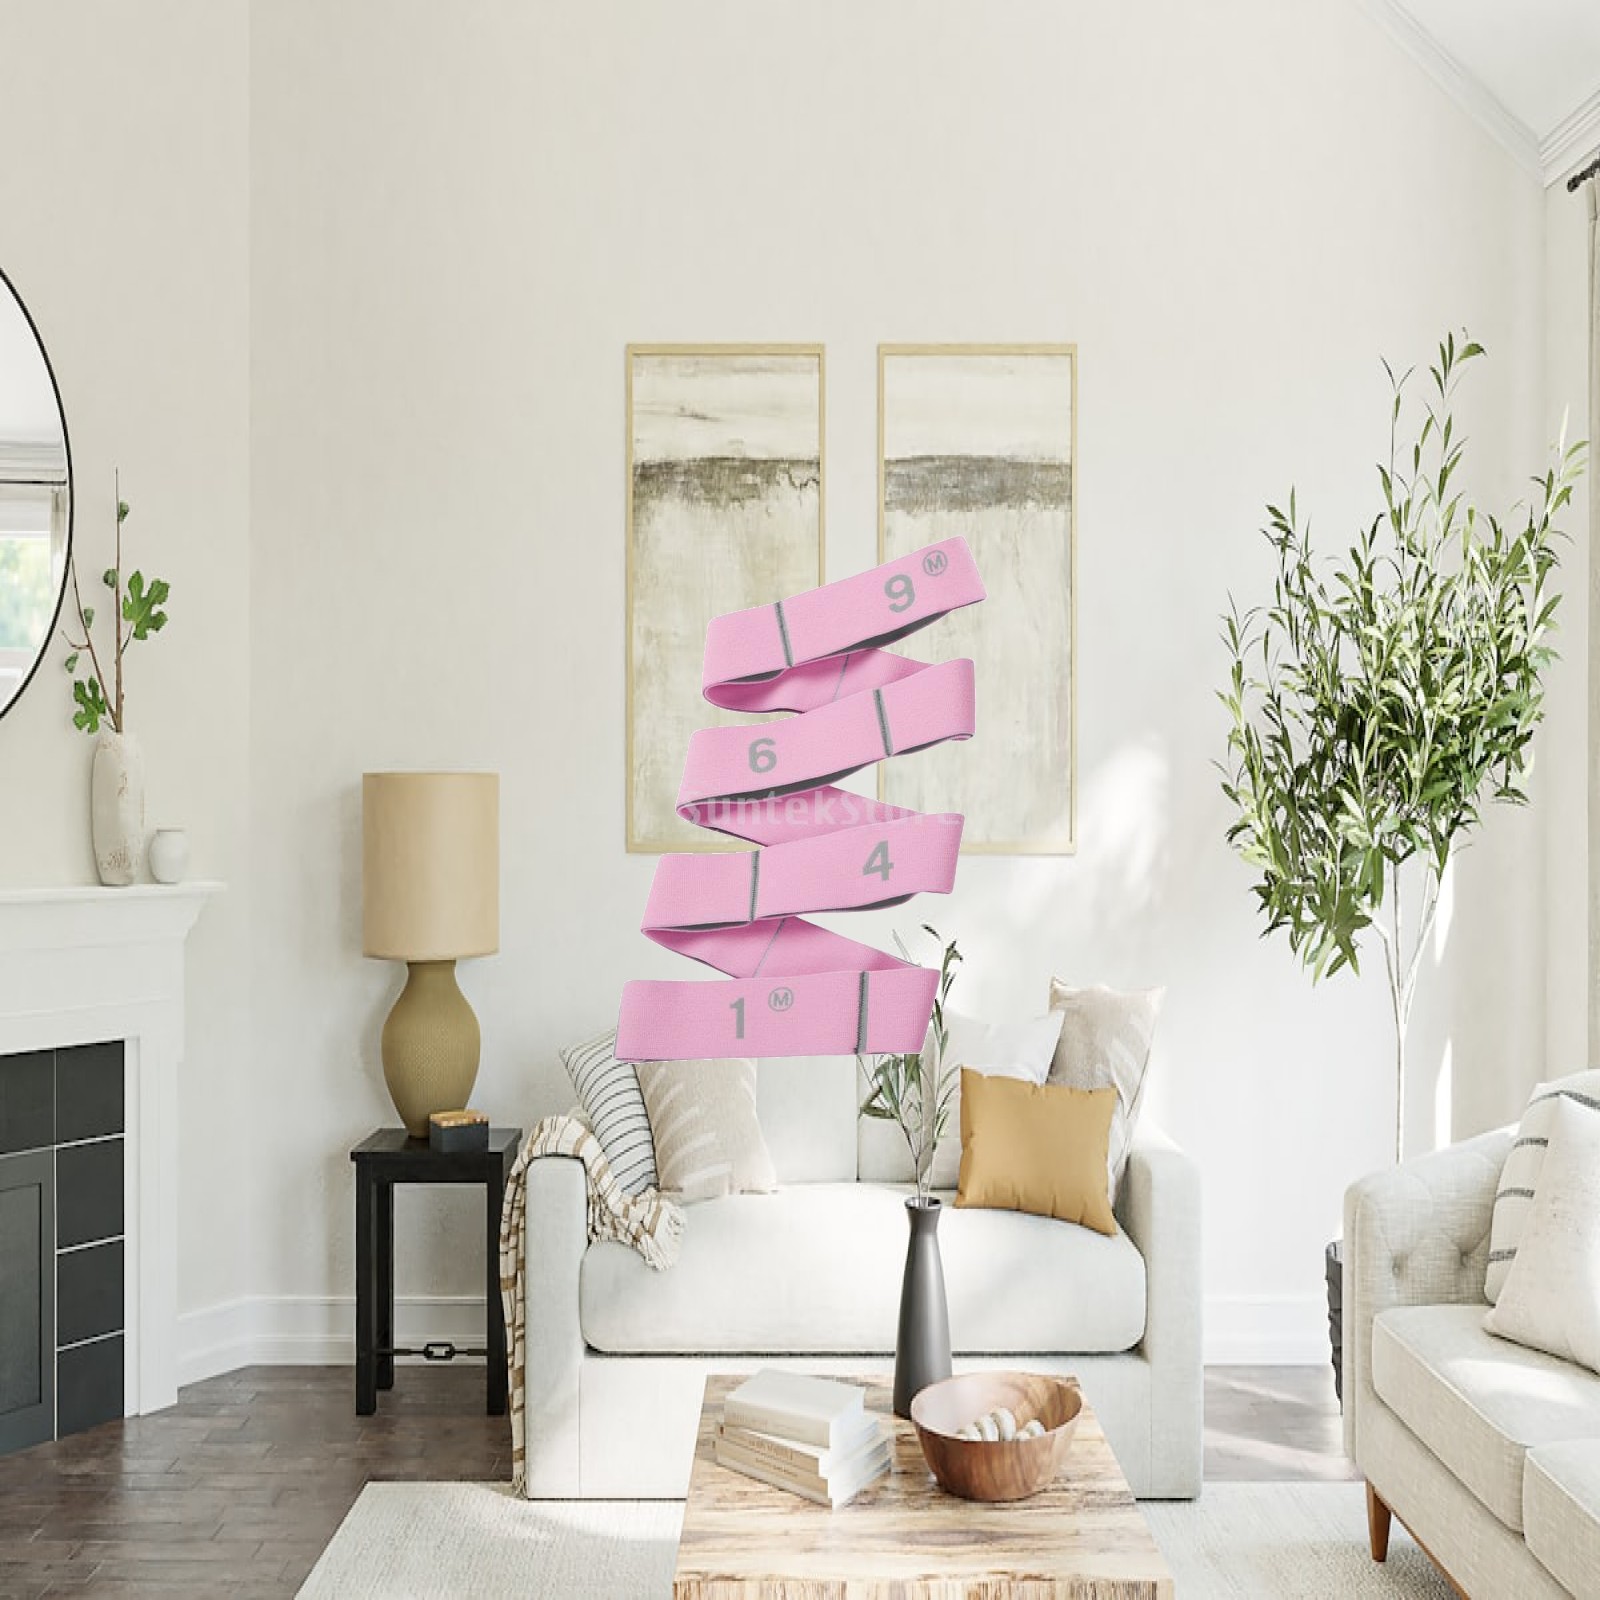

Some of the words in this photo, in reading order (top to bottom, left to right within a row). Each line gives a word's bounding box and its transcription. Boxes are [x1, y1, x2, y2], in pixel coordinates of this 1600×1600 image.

[884, 574, 915, 613] 9
[748, 738, 777, 773] 6
[862, 840, 894, 881] 4
[729, 997, 745, 1038] 1
